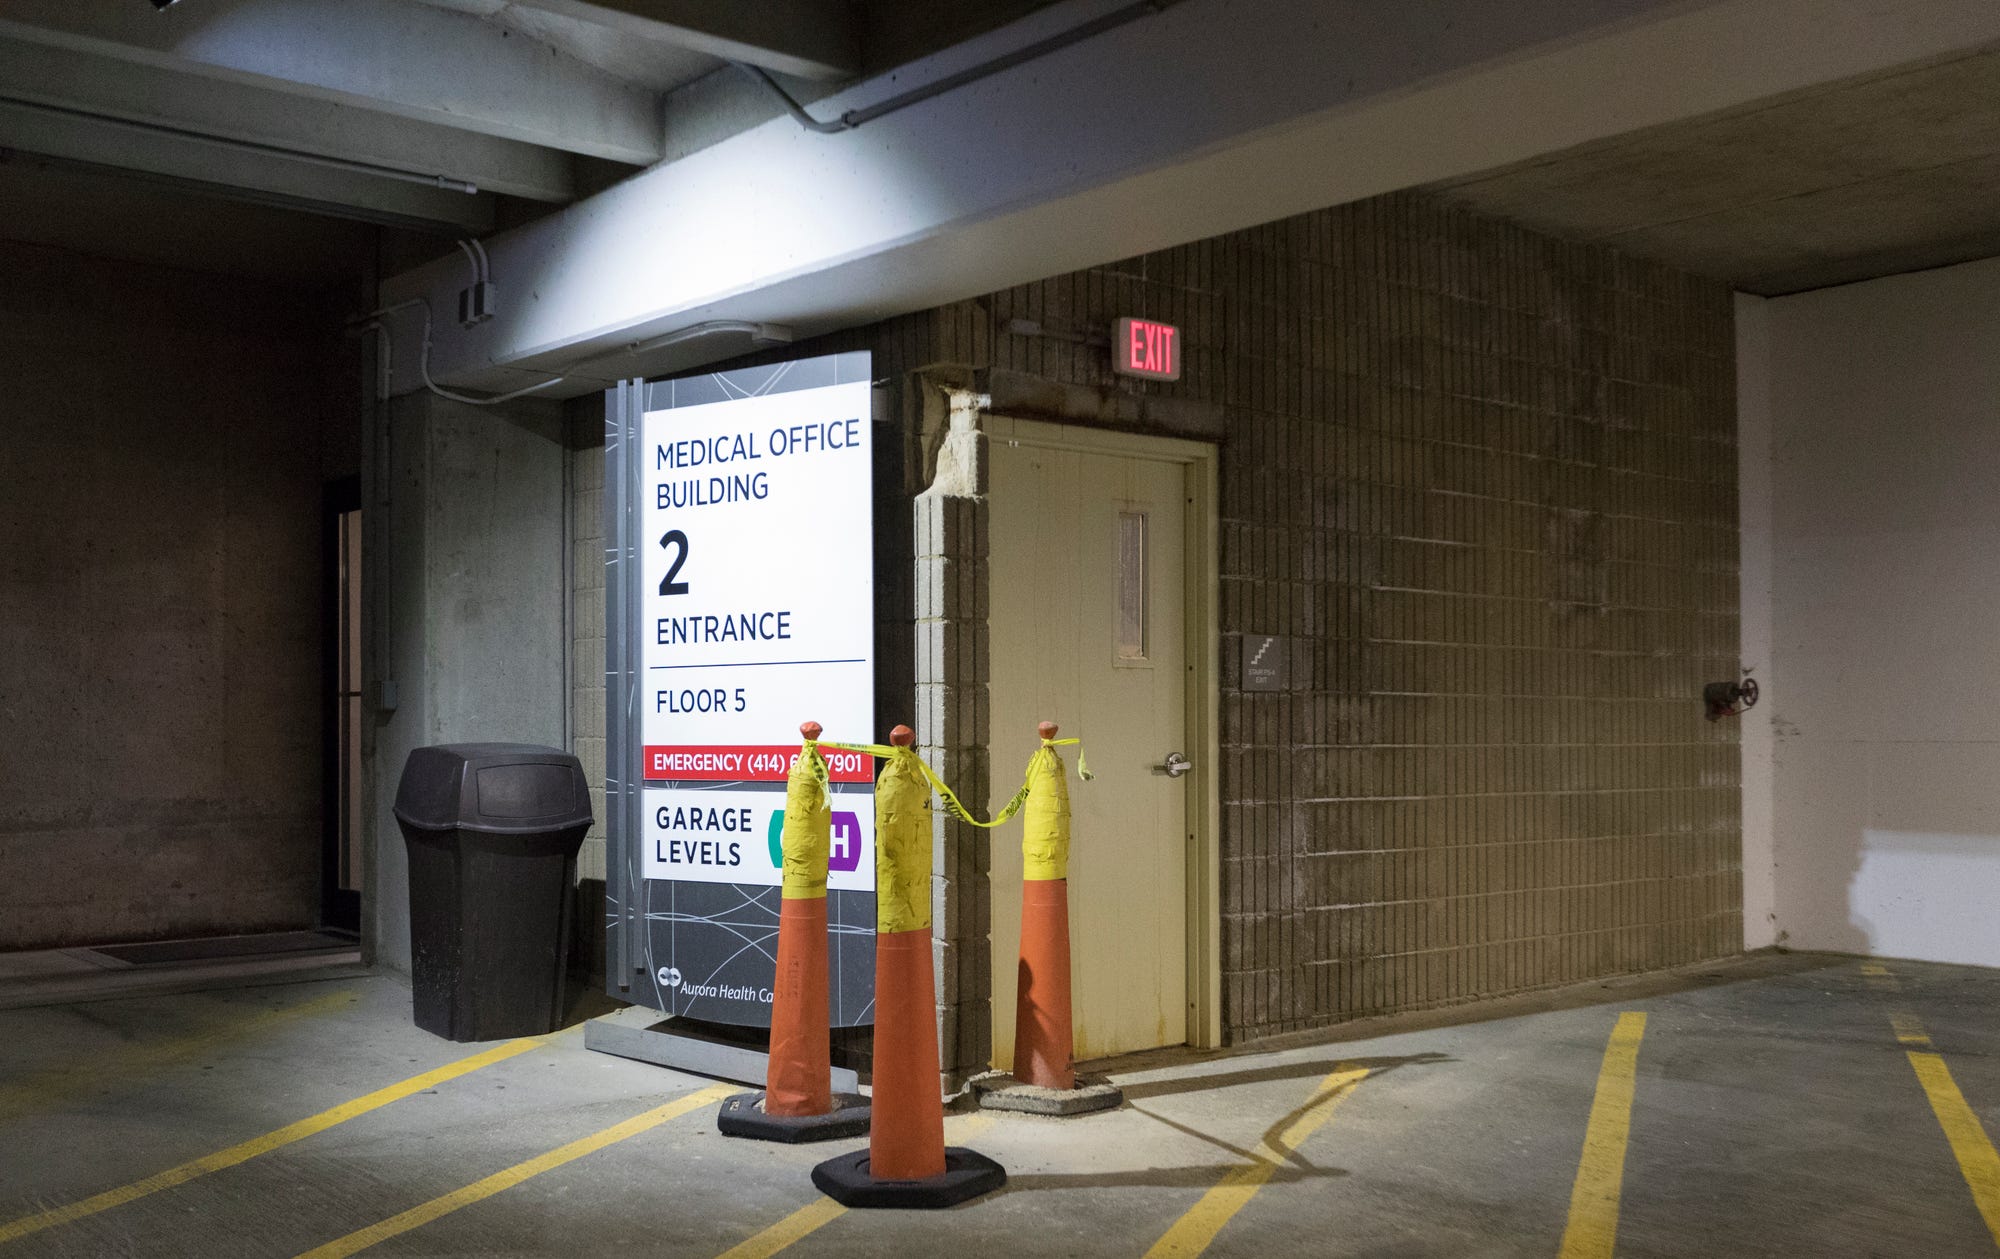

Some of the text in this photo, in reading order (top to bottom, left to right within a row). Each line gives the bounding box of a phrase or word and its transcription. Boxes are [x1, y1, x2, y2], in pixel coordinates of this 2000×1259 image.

[1130, 320, 1174, 374] EXIT
[657, 419, 860, 470] MEDICAL OFFICE
[657, 473, 769, 510] BUILDING
[658, 529, 689, 597] 2
[657, 611, 791, 645] ENTRANCE
[657, 688, 746, 714] FLOOR 5
[654, 753, 744, 771] EMERGENCY
[747, 753, 786, 775] (414)
[656, 806, 752, 833] GARAGE
[656, 839, 741, 867] LEVELS
[829, 824, 849, 859] H
[680, 980, 717, 997] Aurora
[719, 984, 756, 1001] Health
